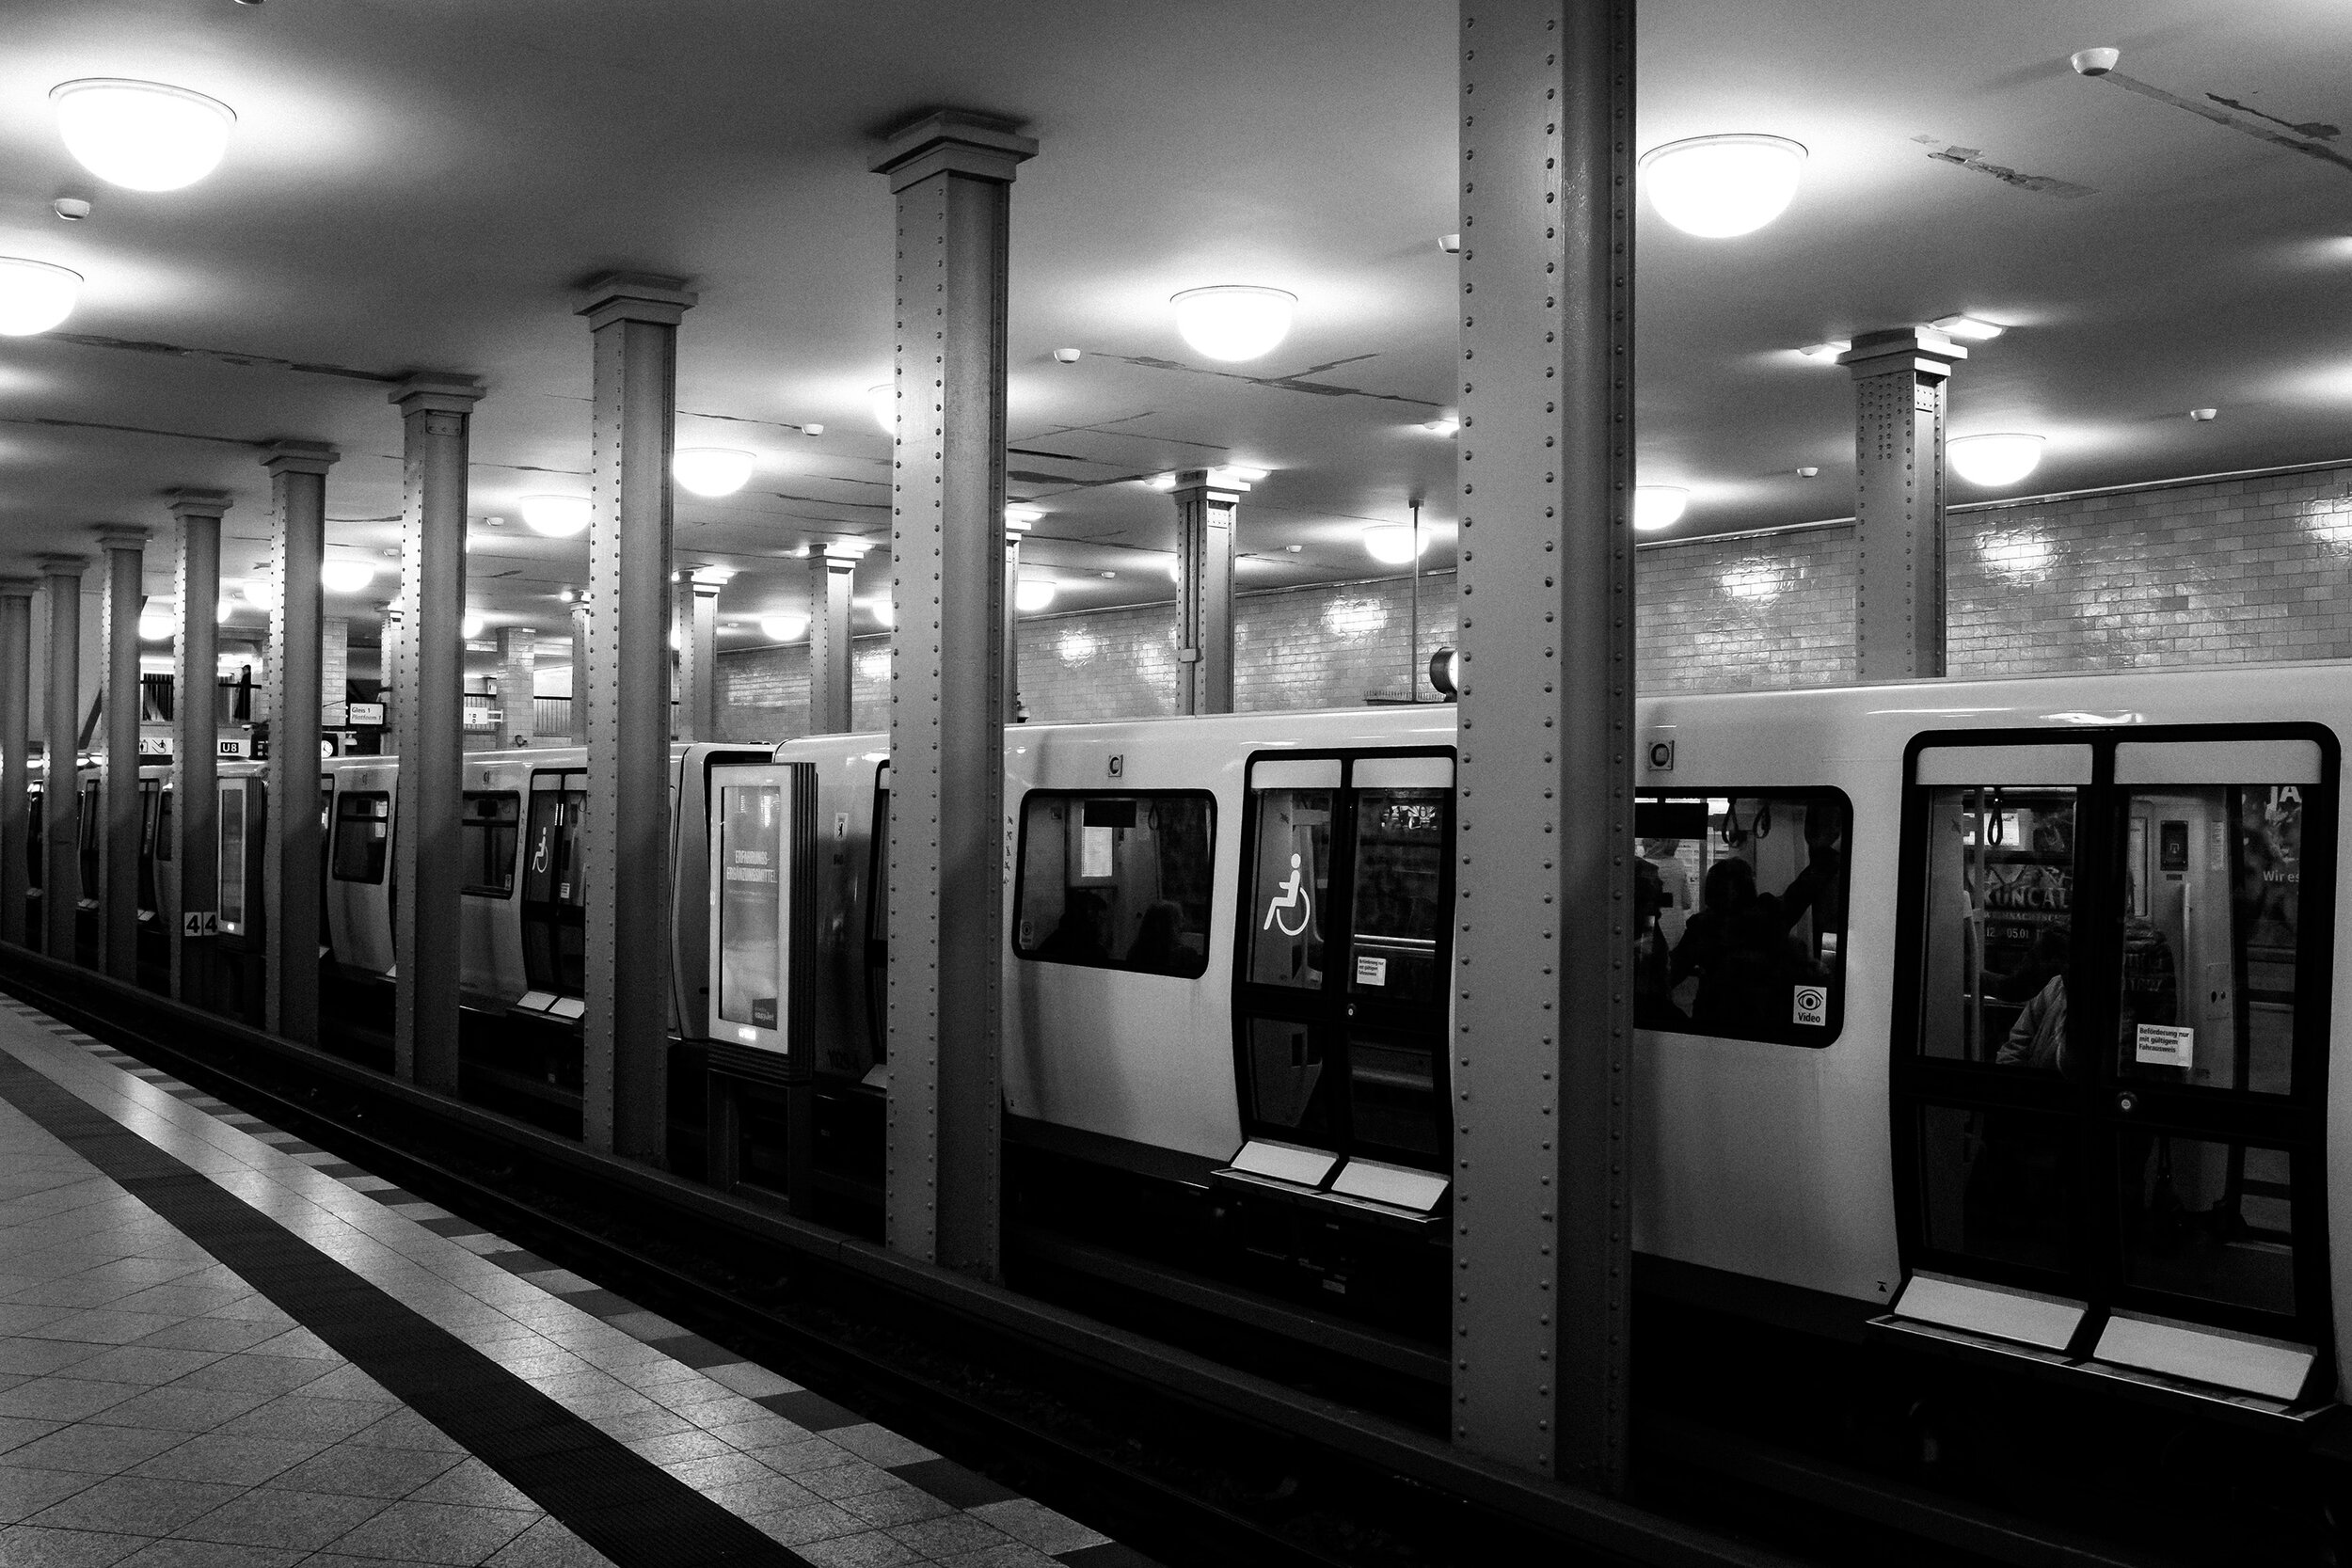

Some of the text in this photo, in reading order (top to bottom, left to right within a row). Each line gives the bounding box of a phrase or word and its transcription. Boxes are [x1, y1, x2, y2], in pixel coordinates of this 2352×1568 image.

[222, 742, 238, 753] U8
[2263, 870, 2284, 882] Wir
[185, 914, 218, 933] 44
[1798, 1012, 1821, 1023] Video
[2139, 1027, 2178, 1038] Beförderung
[2151, 1037, 2179, 1046] gültigem
[2138, 1043, 2176, 1053] Fahrausweis
